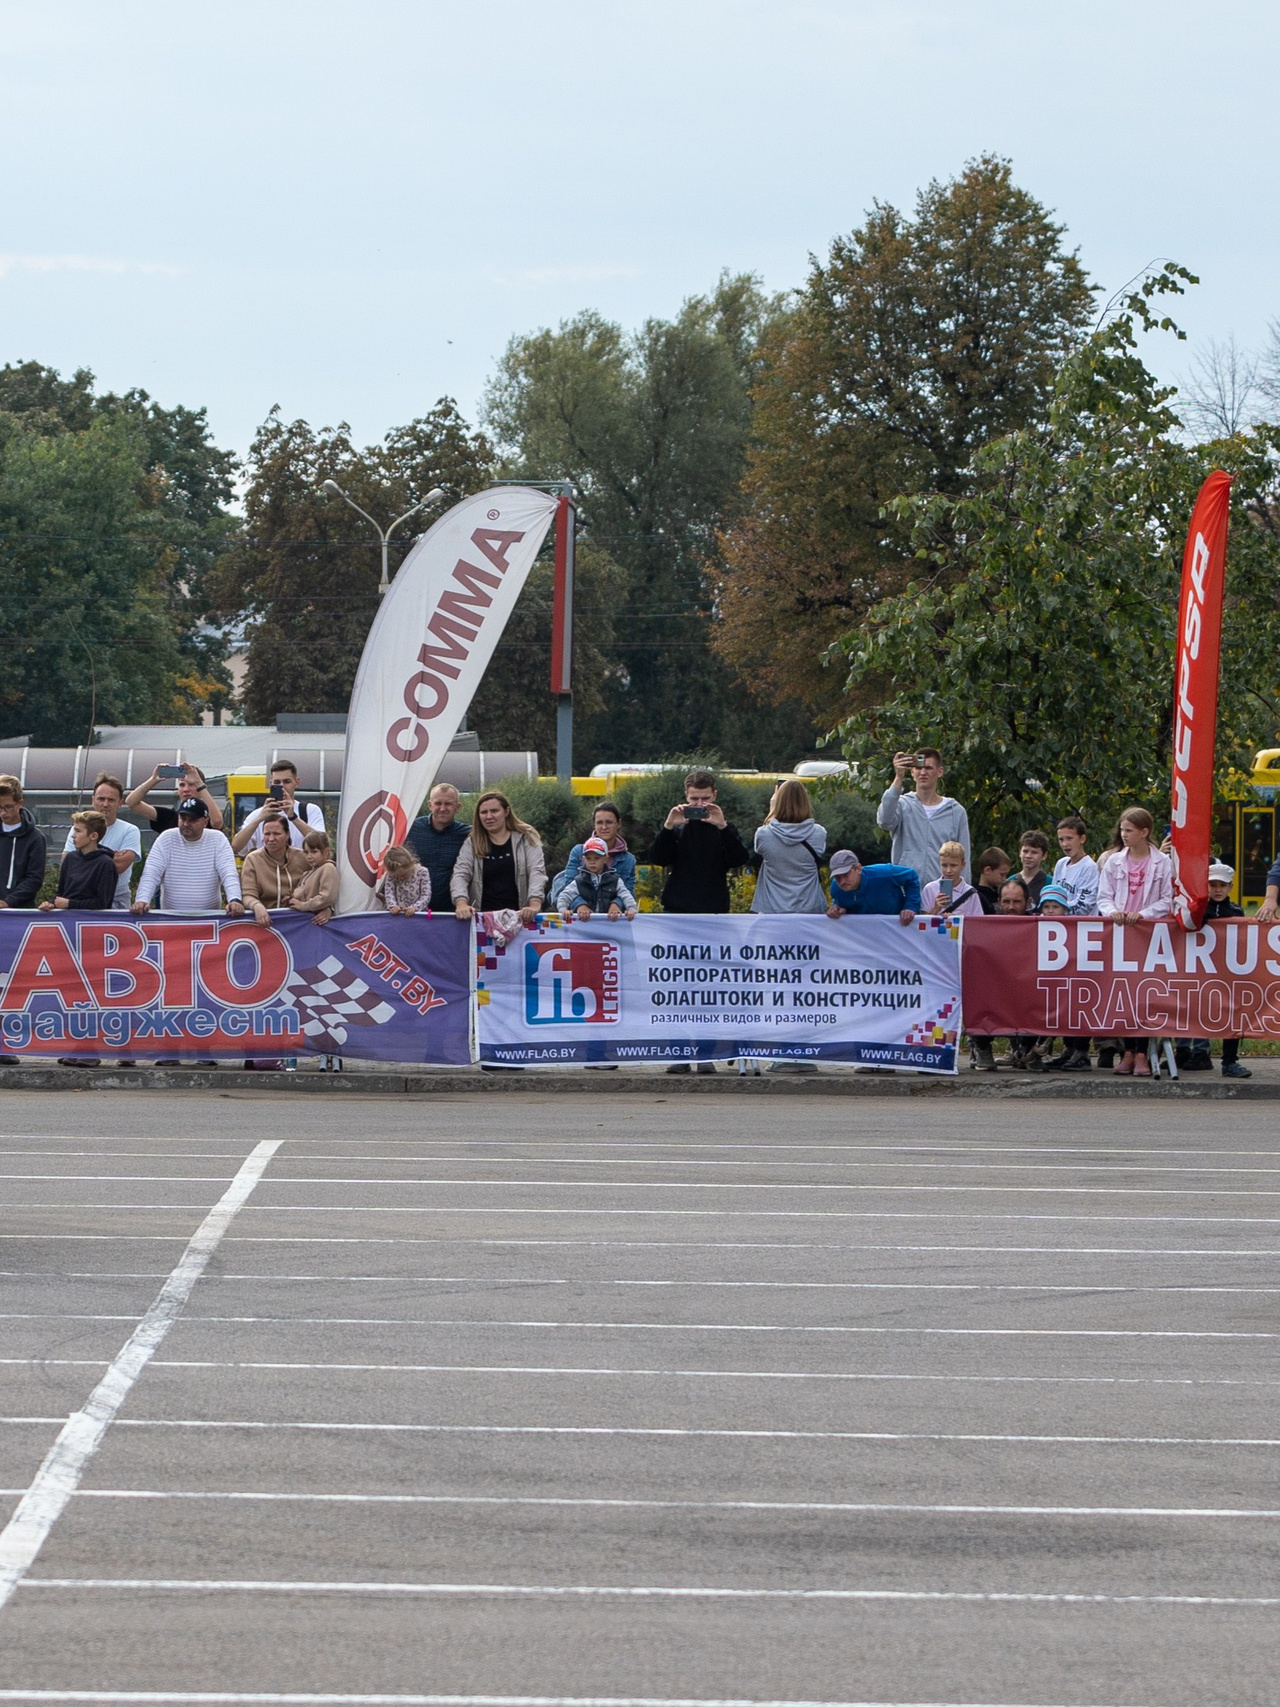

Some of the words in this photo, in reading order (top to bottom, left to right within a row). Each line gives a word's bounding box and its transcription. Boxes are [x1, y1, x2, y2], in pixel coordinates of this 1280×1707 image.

[386, 527, 526, 762] COMMA
[651, 945, 712, 961] ФЛАГИ
[720, 945, 732, 960] И
[739, 945, 820, 961] ФЛАЖКИ
[346, 933, 448, 1016] ADT.BY
[602, 943, 618, 1021] FLAGBY
[648, 967, 802, 984] КОРПОРАТИВНАЯ
[810, 969, 923, 985] СИМВОЛИКА
[651, 990, 764, 1007] ФЛАГШТОКИ
[772, 992, 784, 1006] И
[793, 992, 922, 1010] КОНСТРУКЦИИ
[651, 1013, 720, 1025] различных
[723, 1013, 761, 1024] видов
[764, 1014, 772, 1023] и
[775, 1013, 837, 1026] размеров
[495, 1048, 576, 1060] WWW.FLAG.BY
[616, 1046, 699, 1056] WWW.FLAG.BY
[738, 1046, 821, 1056] WWW.FLAG.BY
[860, 1048, 941, 1063] WWW.FLAG.BY
